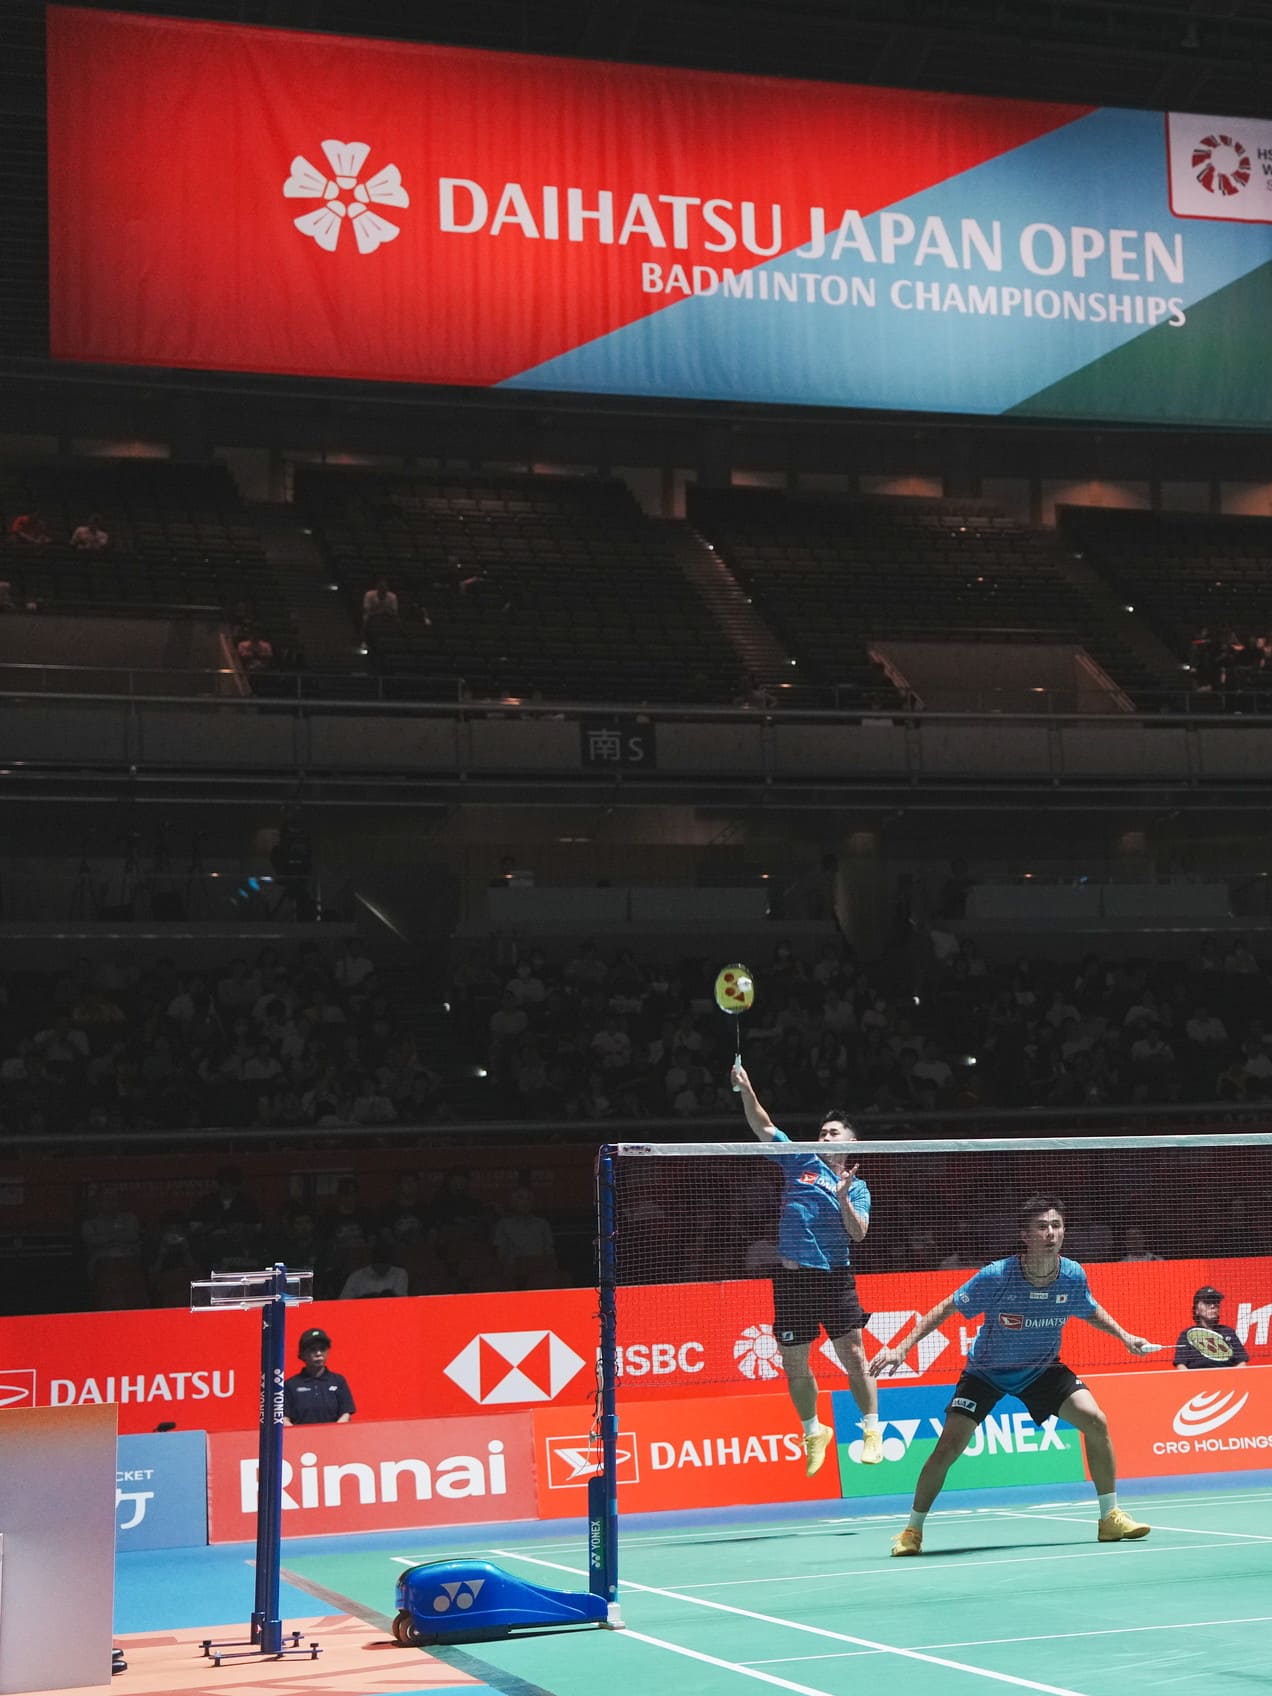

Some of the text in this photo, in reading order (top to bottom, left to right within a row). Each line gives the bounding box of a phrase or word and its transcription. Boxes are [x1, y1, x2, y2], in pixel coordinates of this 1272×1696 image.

[439, 176, 1185, 284] DAIHATSU JAPAN OPEN
[642, 262, 1187, 327] BADMINTON CHAMPIONSHIPS
[50, 1369, 235, 1407] DAIHATSU
[273, 1390, 285, 1425] YONEX
[650, 1433, 808, 1471] DAIHATS
[1152, 1441, 1191, 1455] CRG
[240, 1439, 507, 1513] Rinnai
[591, 1519, 601, 1551] YONEX
